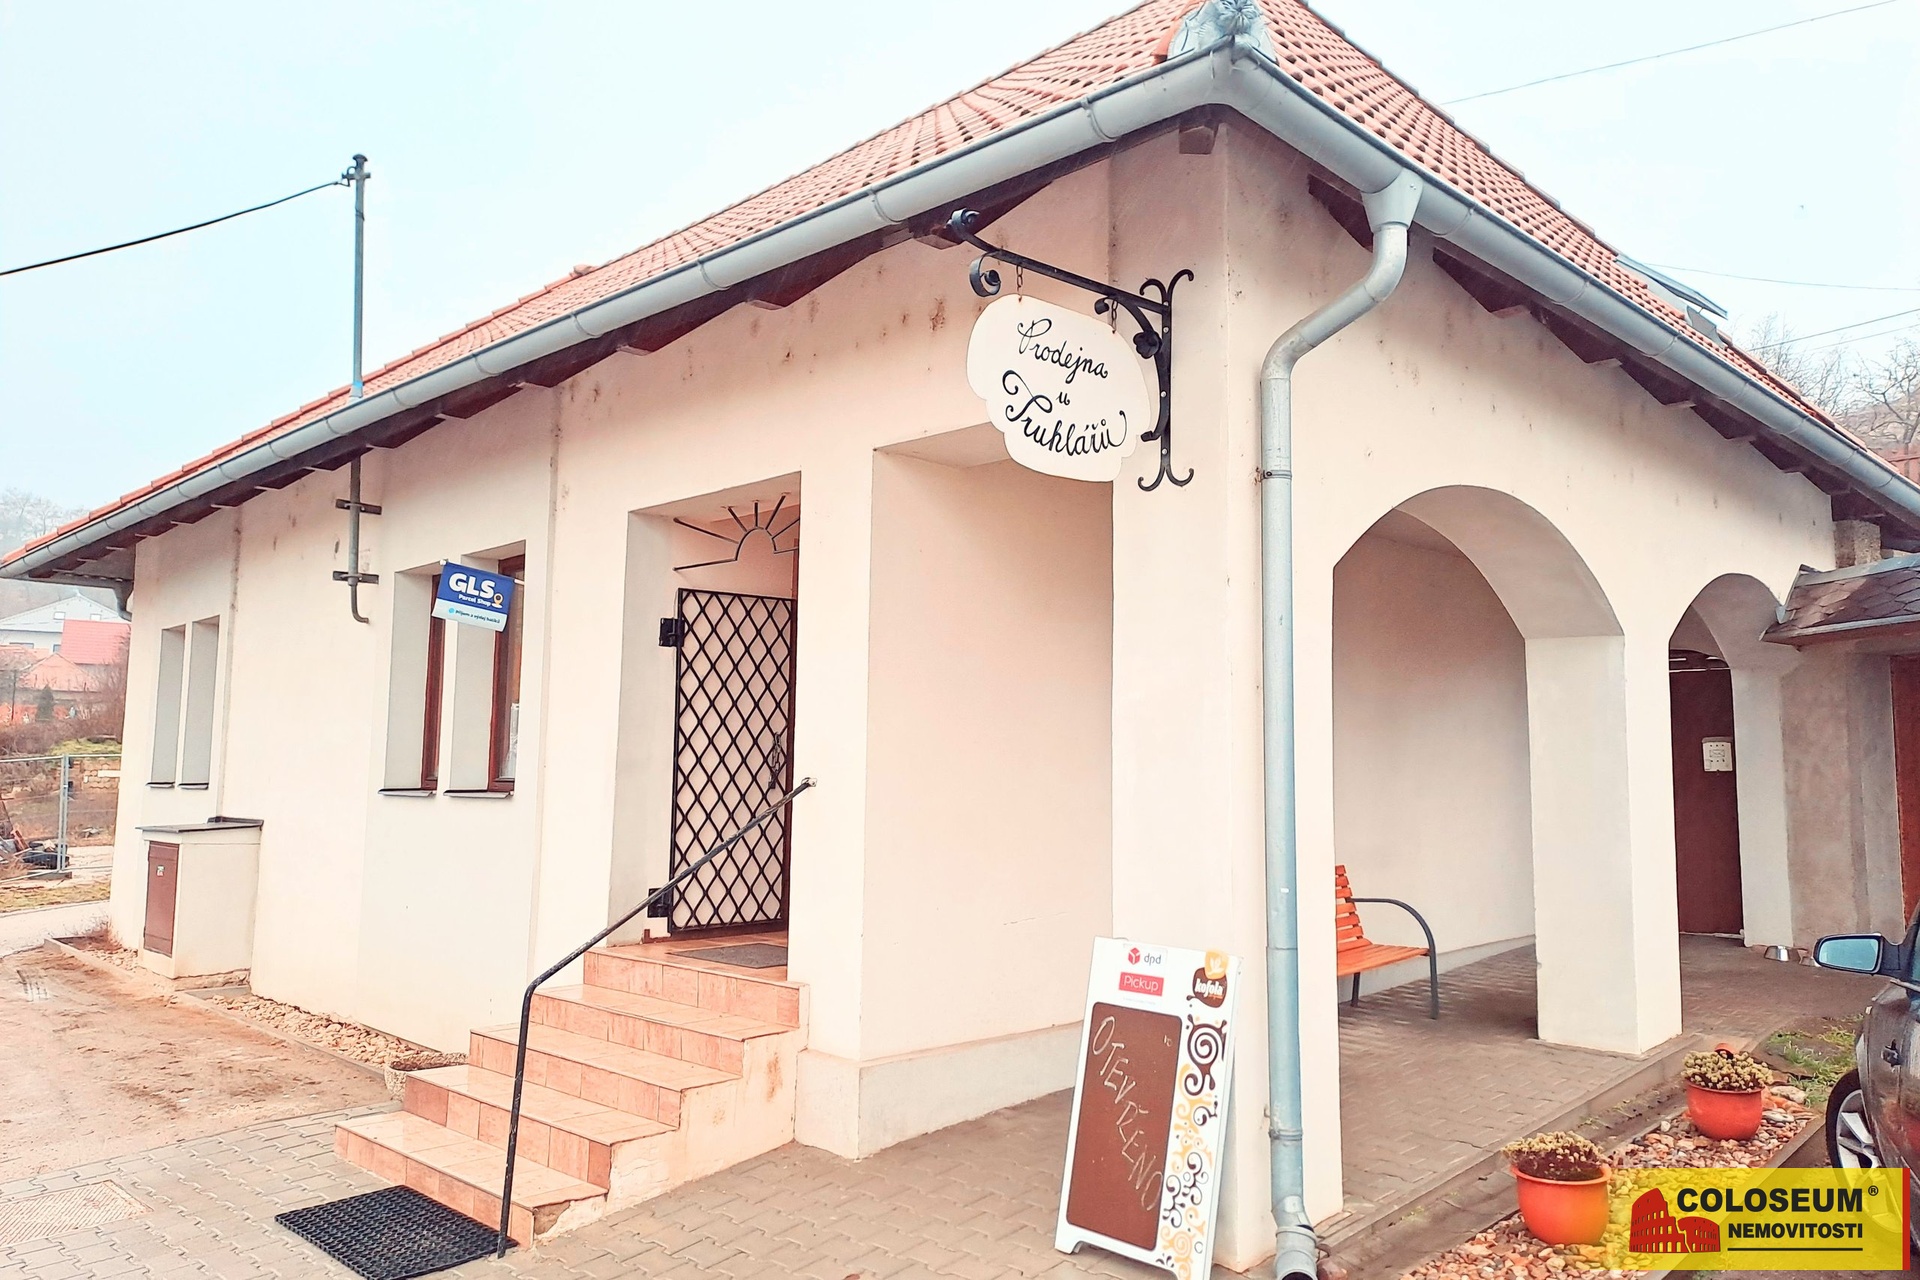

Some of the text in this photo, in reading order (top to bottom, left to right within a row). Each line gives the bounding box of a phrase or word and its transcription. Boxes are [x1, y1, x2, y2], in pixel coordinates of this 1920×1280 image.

[1017, 318, 1109, 384] Prodejna
[1056, 391, 1070, 406] u
[1002, 369, 1128, 456] Truhlářů
[449, 573, 495, 599] GLS
[459, 594, 491, 607] Parcel Shop
[1143, 953, 1162, 966] dpd
[1123, 975, 1159, 993] Pickup
[1194, 978, 1223, 997] kofola
[1092, 1015, 1164, 1211] OTEVŘENO
